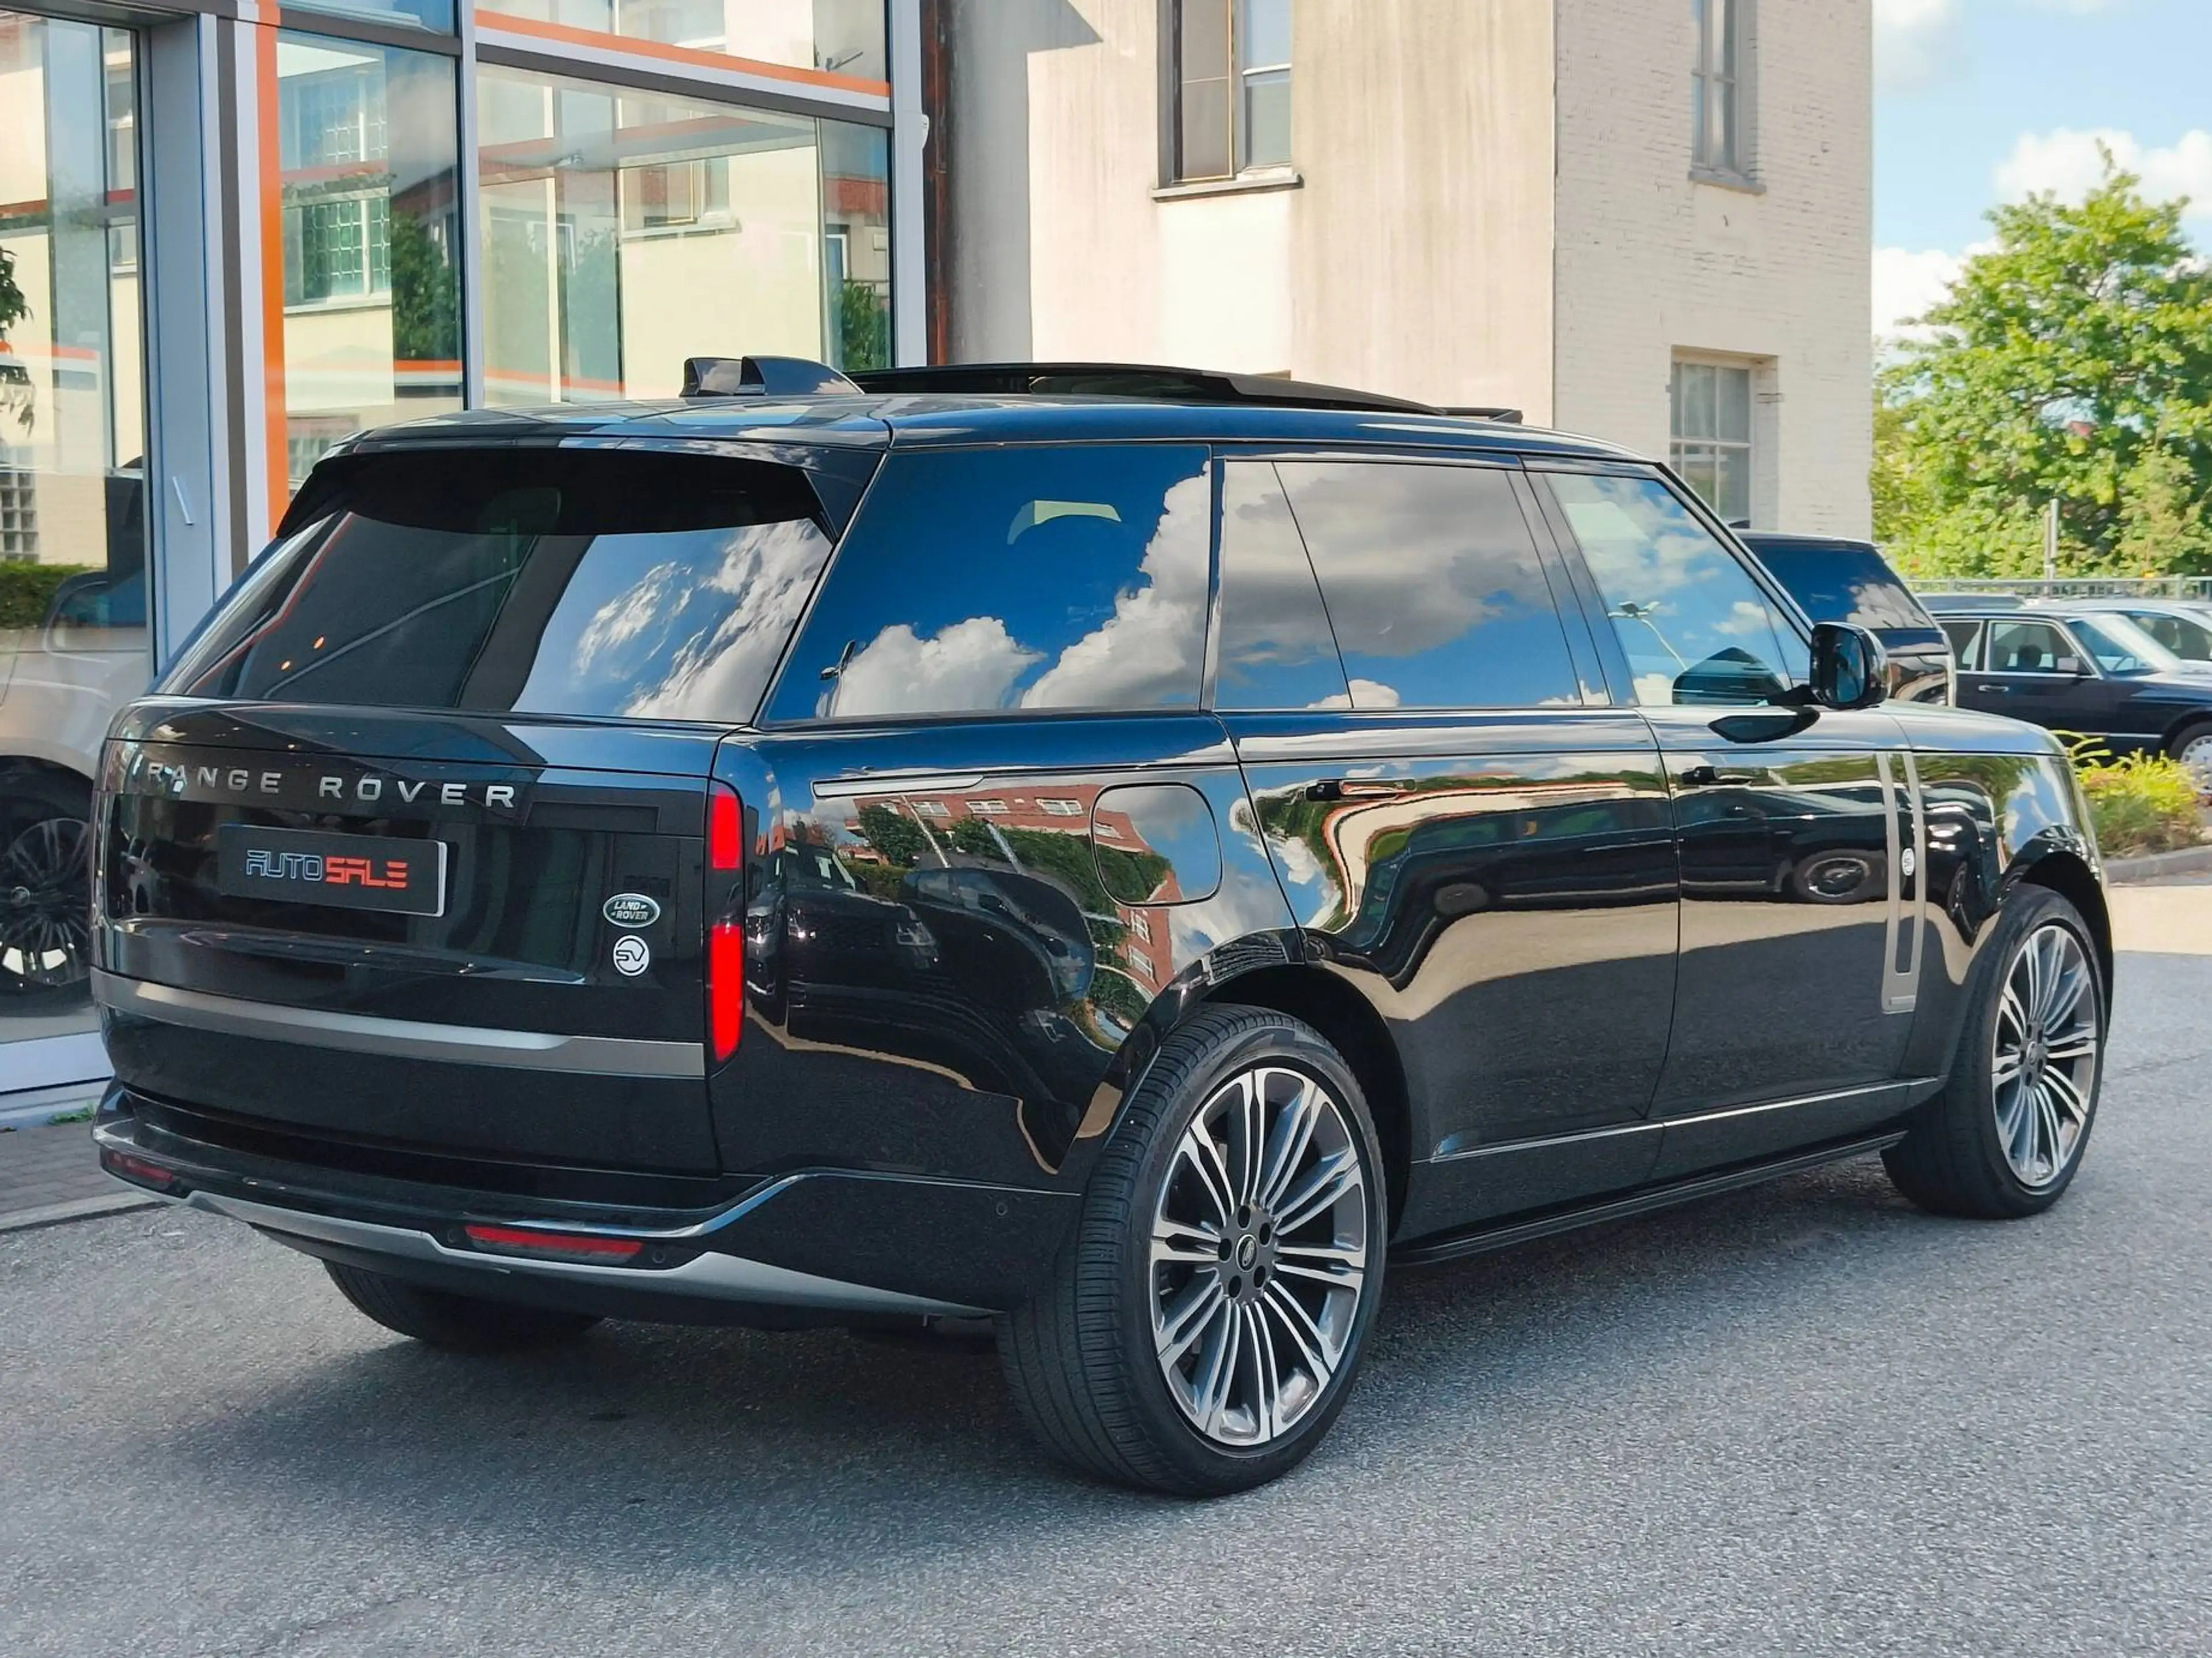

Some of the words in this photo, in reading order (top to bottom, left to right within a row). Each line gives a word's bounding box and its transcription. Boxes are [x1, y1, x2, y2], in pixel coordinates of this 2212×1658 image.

[146, 761, 282, 794] RANGE
[318, 776, 515, 808] ROVER
[614, 901, 641, 910] LAND
[616, 910, 649, 920] ROVER
